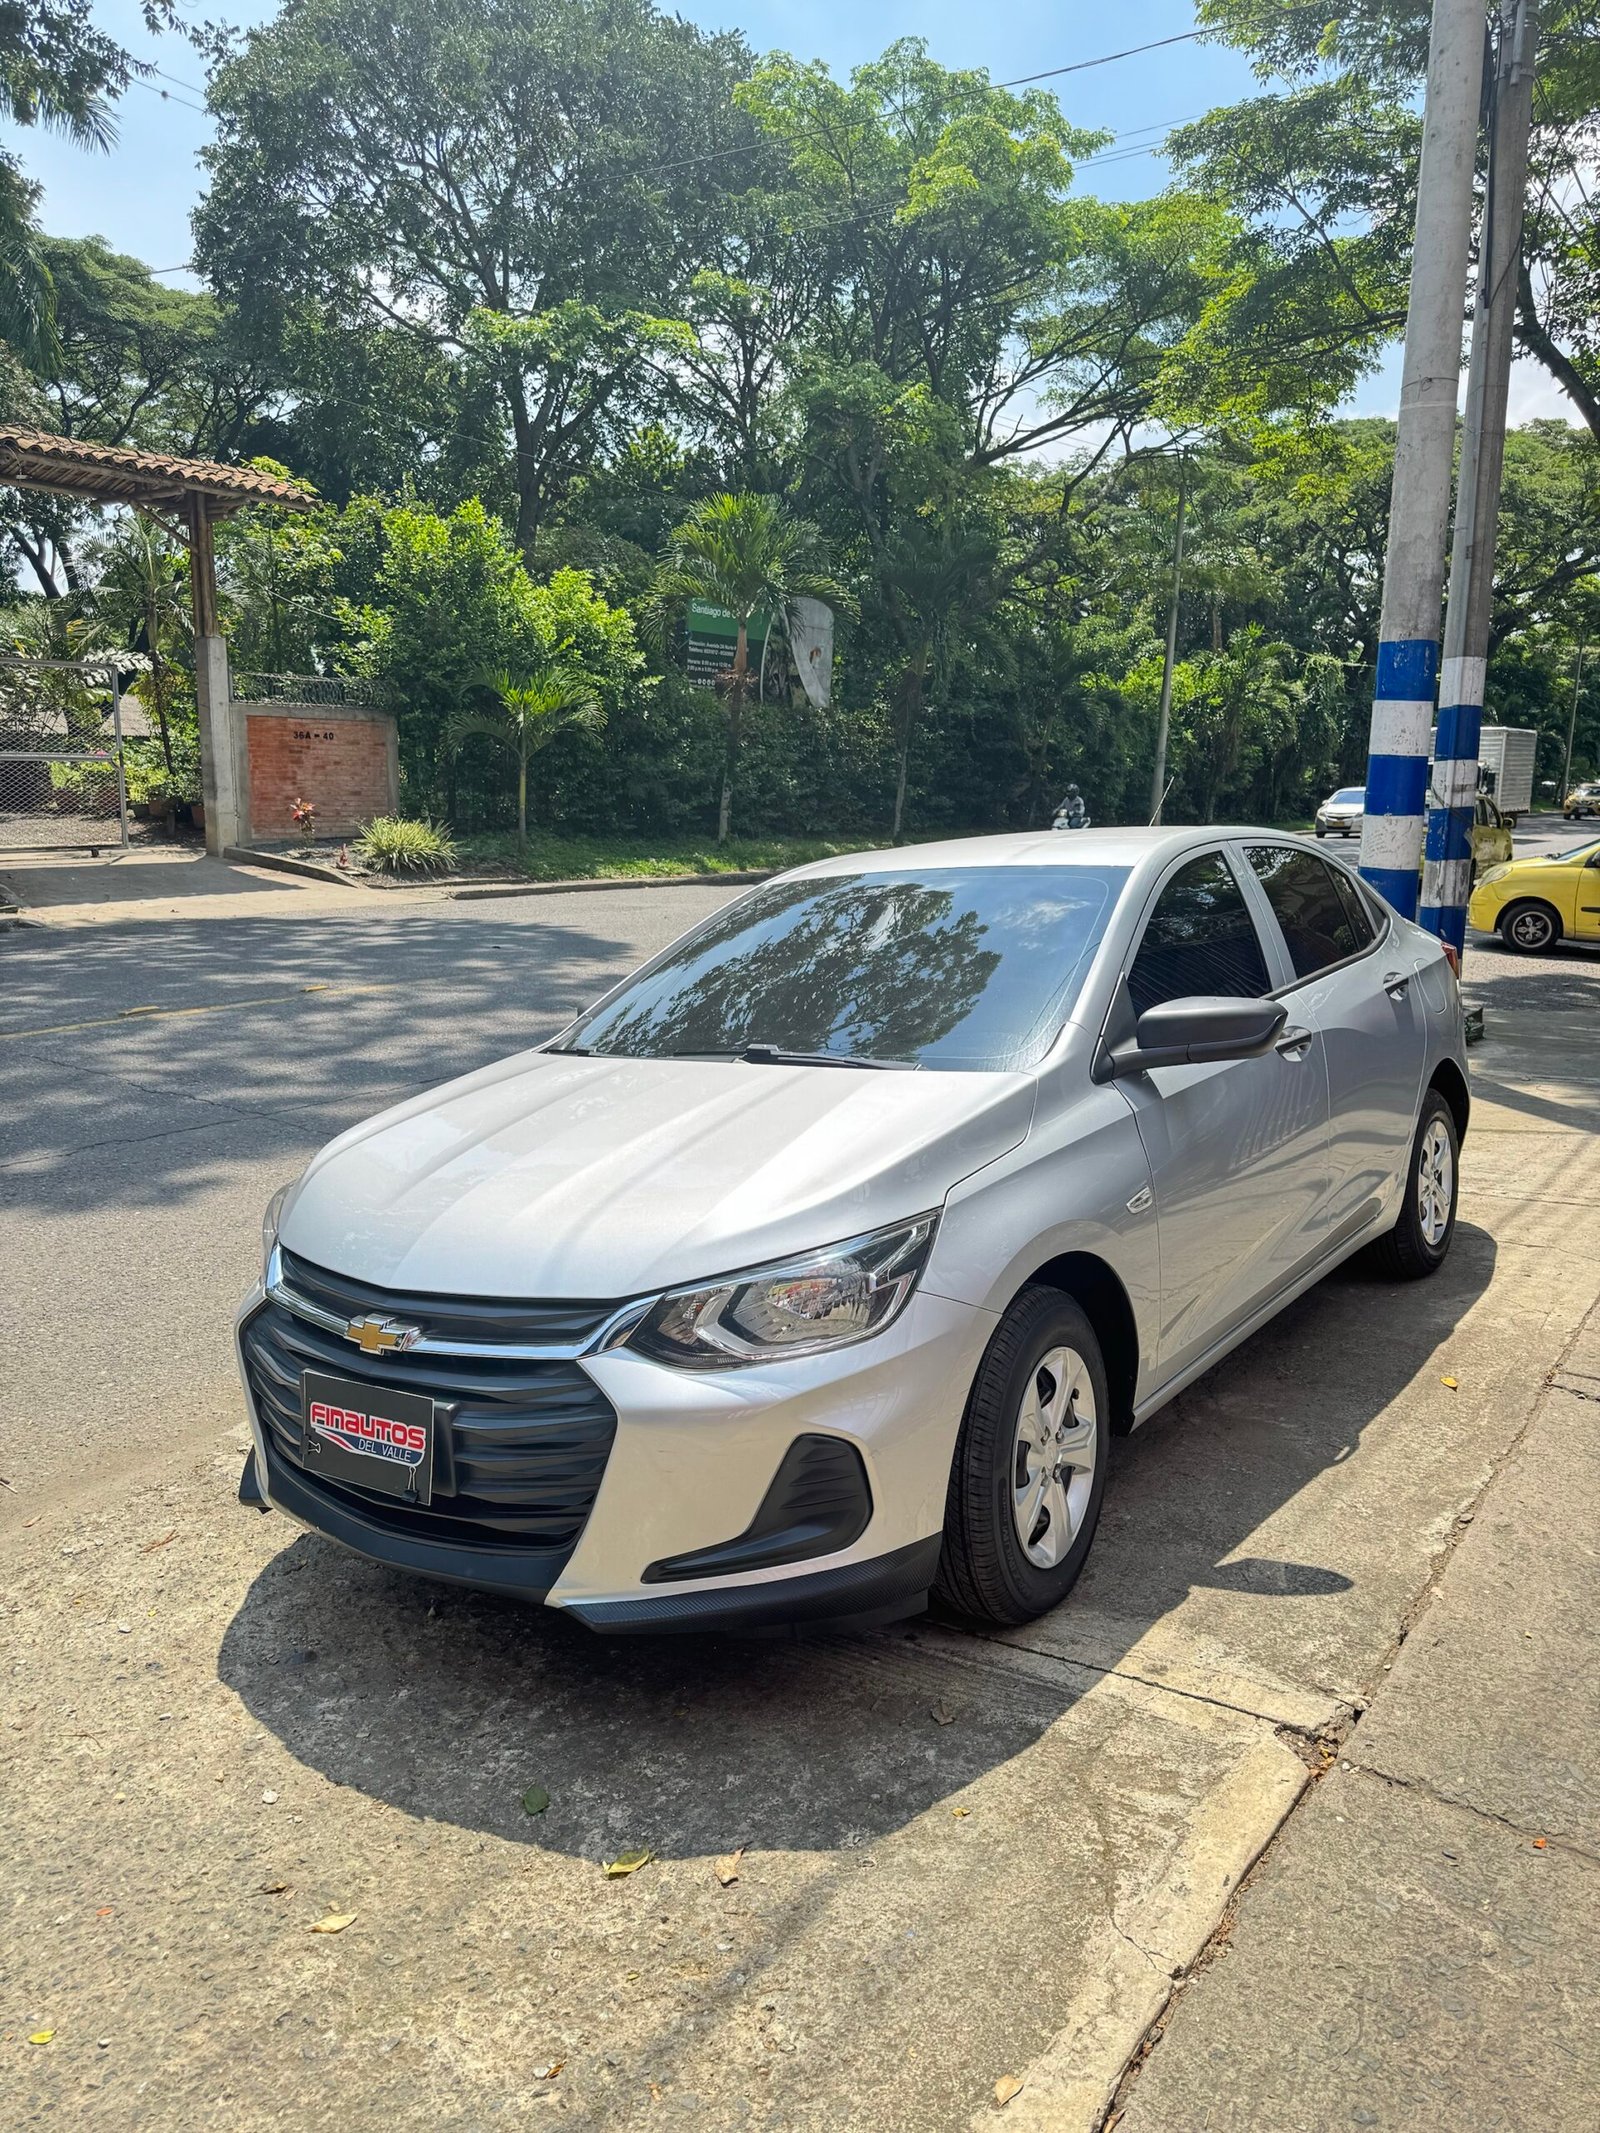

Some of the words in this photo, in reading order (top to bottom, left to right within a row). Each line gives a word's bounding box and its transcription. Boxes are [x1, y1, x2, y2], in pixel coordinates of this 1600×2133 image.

[691, 602, 722, 619] Santiago
[722, 607, 731, 618] de
[293, 731, 311, 740] 36A
[323, 732, 334, 740] 40
[310, 1402, 426, 1453] FINAUTOS
[358, 1438, 378, 1454] DEL
[382, 1447, 412, 1462] VALLE
